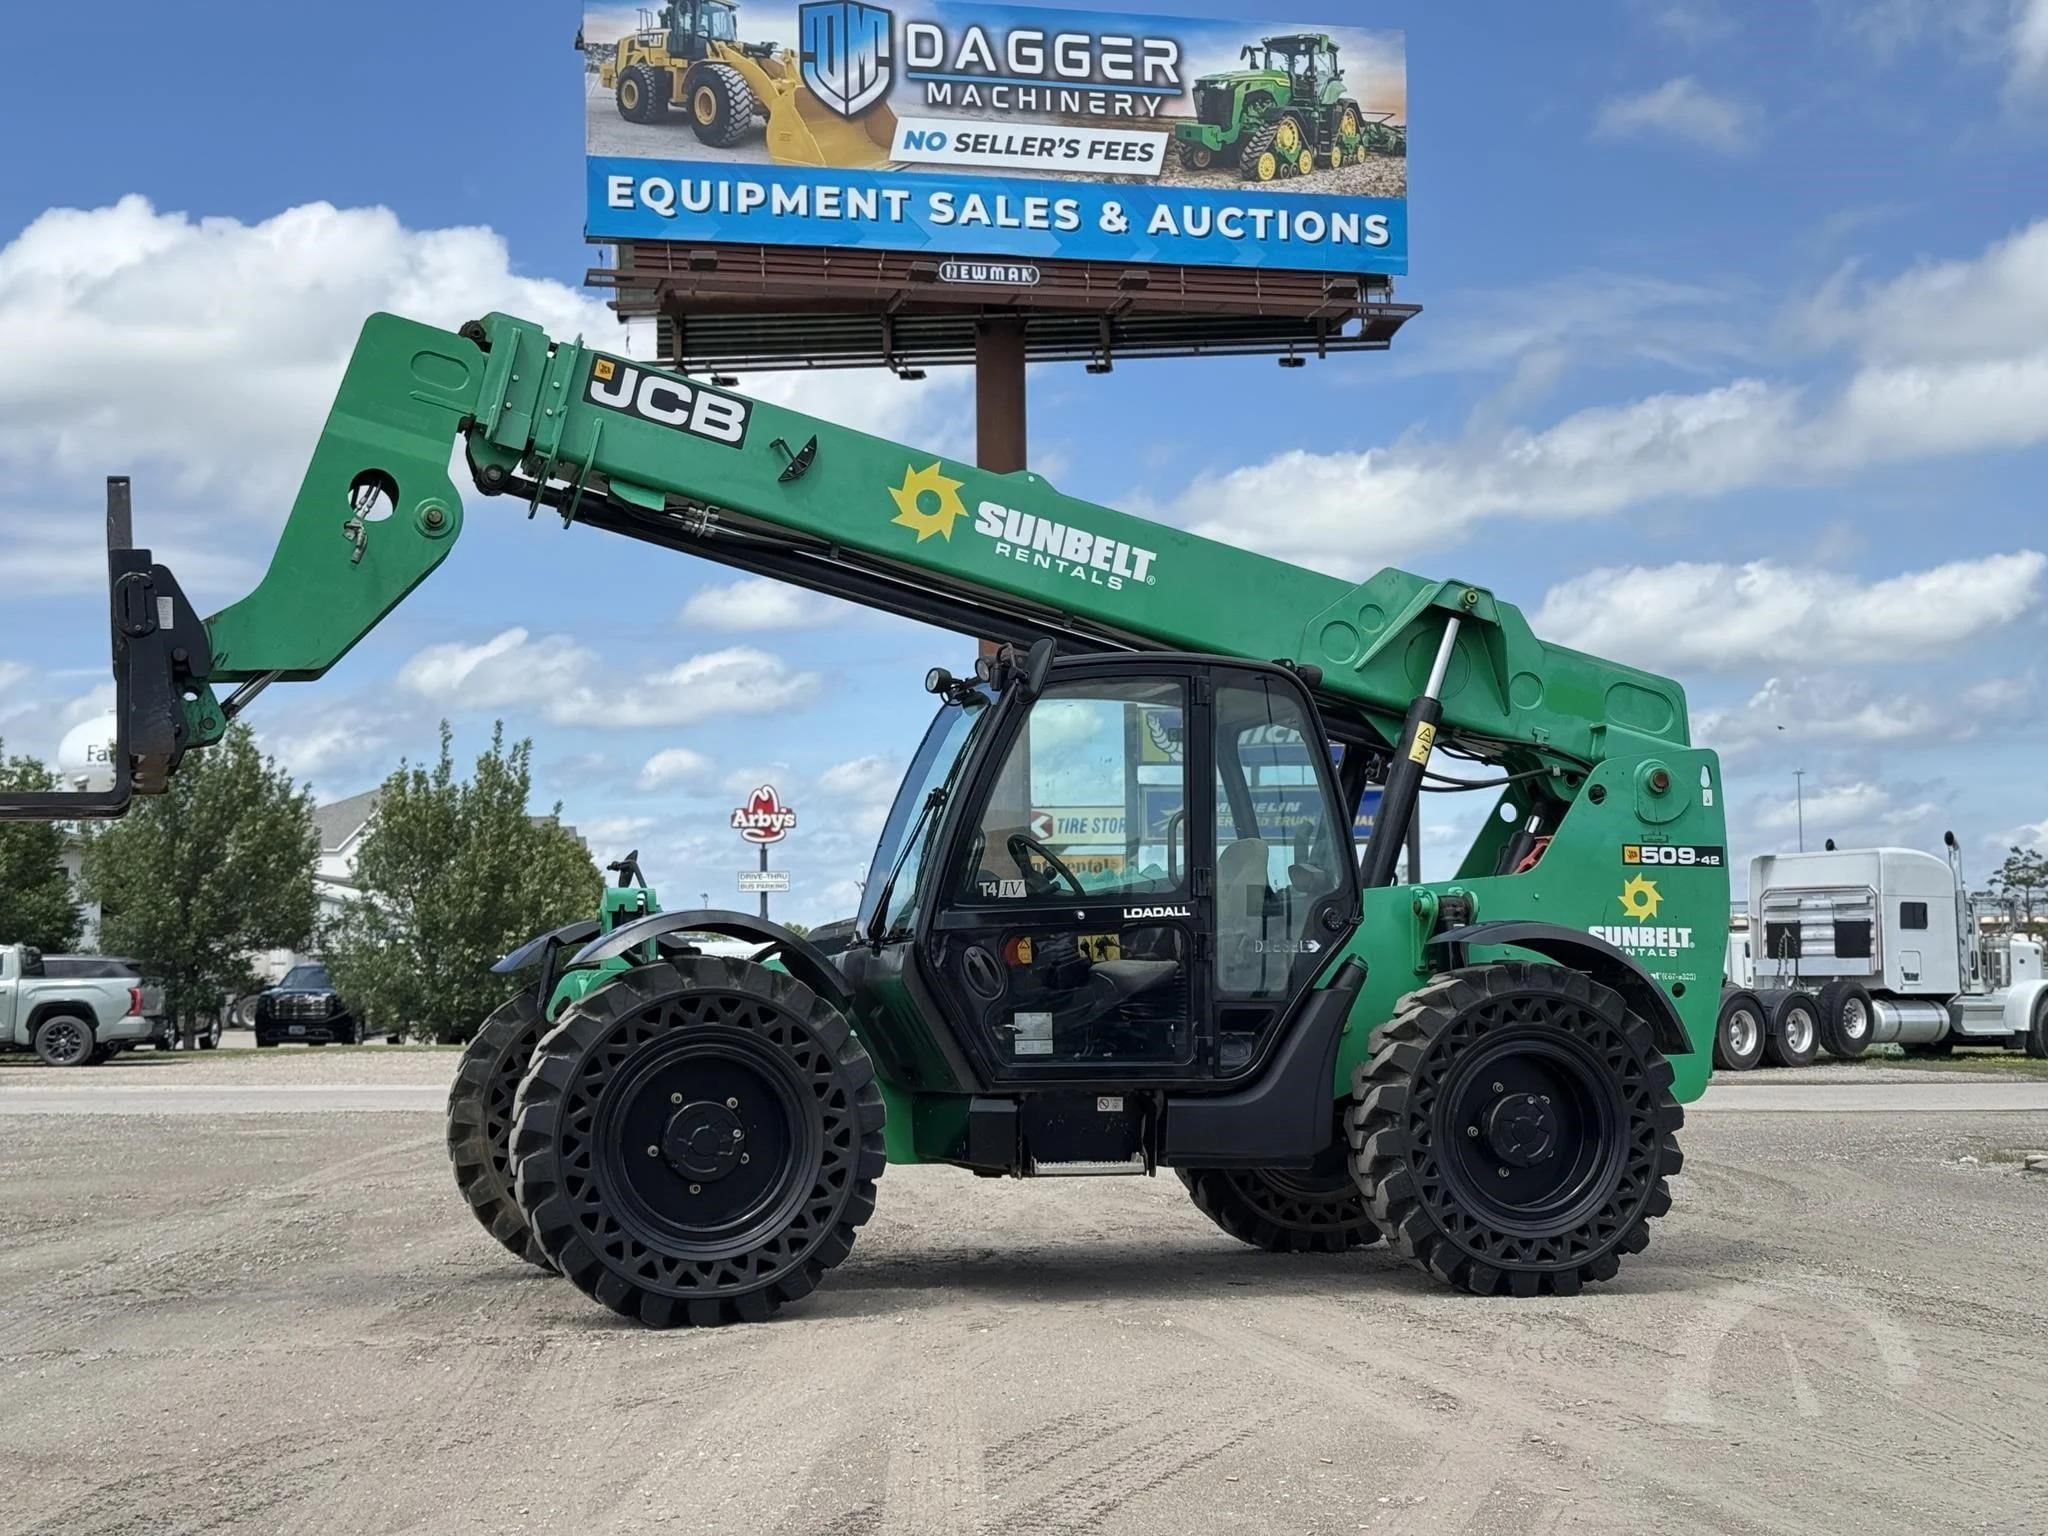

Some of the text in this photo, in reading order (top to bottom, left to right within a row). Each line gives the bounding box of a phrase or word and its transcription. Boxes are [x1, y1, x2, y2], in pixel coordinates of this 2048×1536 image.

[906, 23, 1180, 84] DAGGER
[927, 82, 1162, 117] MACHINERY
[903, 130, 948, 151] NO
[1087, 139, 1155, 163] FEES
[607, 175, 1390, 246] EQUIPMENT SALES & AUCTIONS
[946, 265, 1033, 282] NEWMAN
[589, 367, 746, 443] JCB
[994, 541, 1124, 591] RENTALS
[732, 809, 796, 832] Arby's
[1057, 817, 1089, 834] TIRE
[1641, 846, 1720, 866] 509-42
[1123, 906, 1191, 919] LOADALL
[1620, 948, 1678, 957] NTALS
